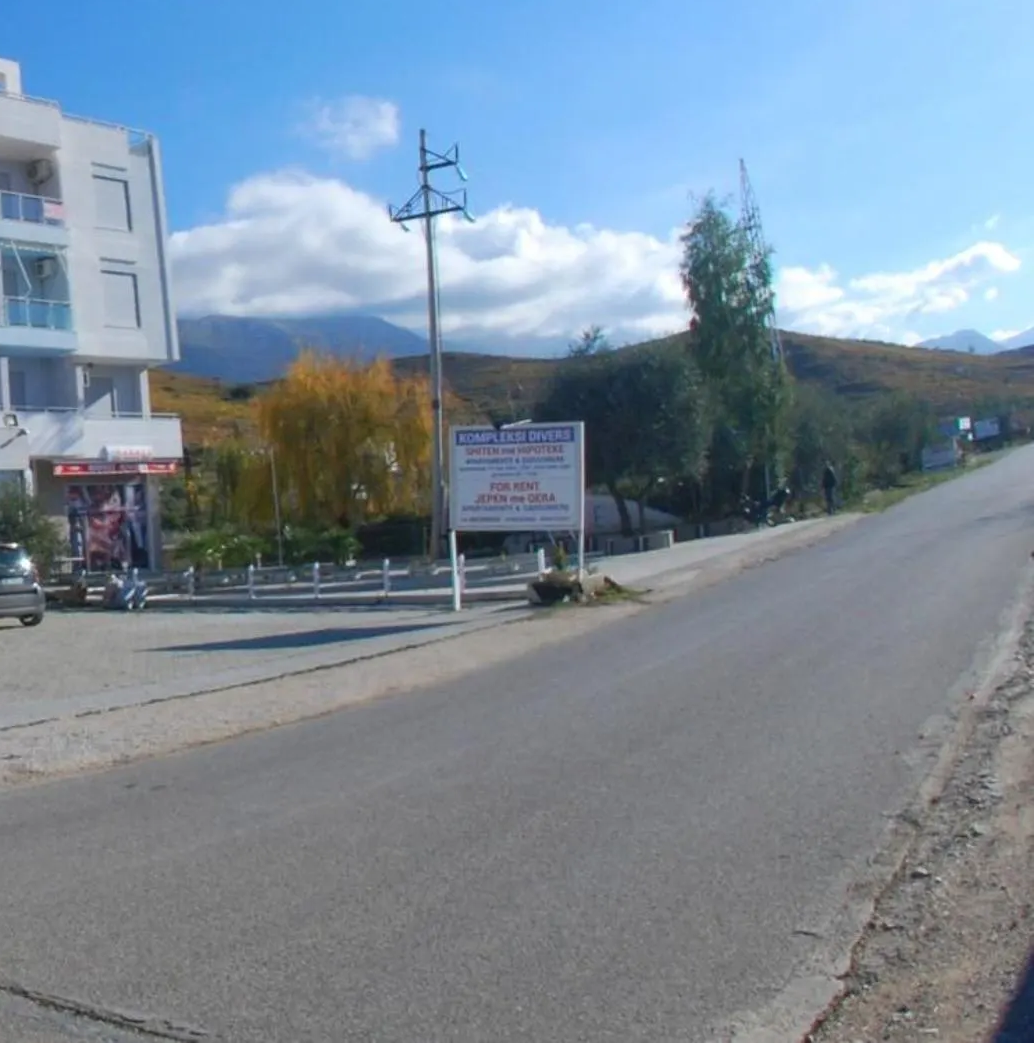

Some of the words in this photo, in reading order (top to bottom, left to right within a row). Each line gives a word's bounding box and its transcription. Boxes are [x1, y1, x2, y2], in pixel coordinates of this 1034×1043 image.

[459, 430, 526, 443] KOMPLEKSI
[528, 428, 571, 441] DIVERS
[489, 482, 512, 492] FOR
[513, 481, 540, 491] RENT
